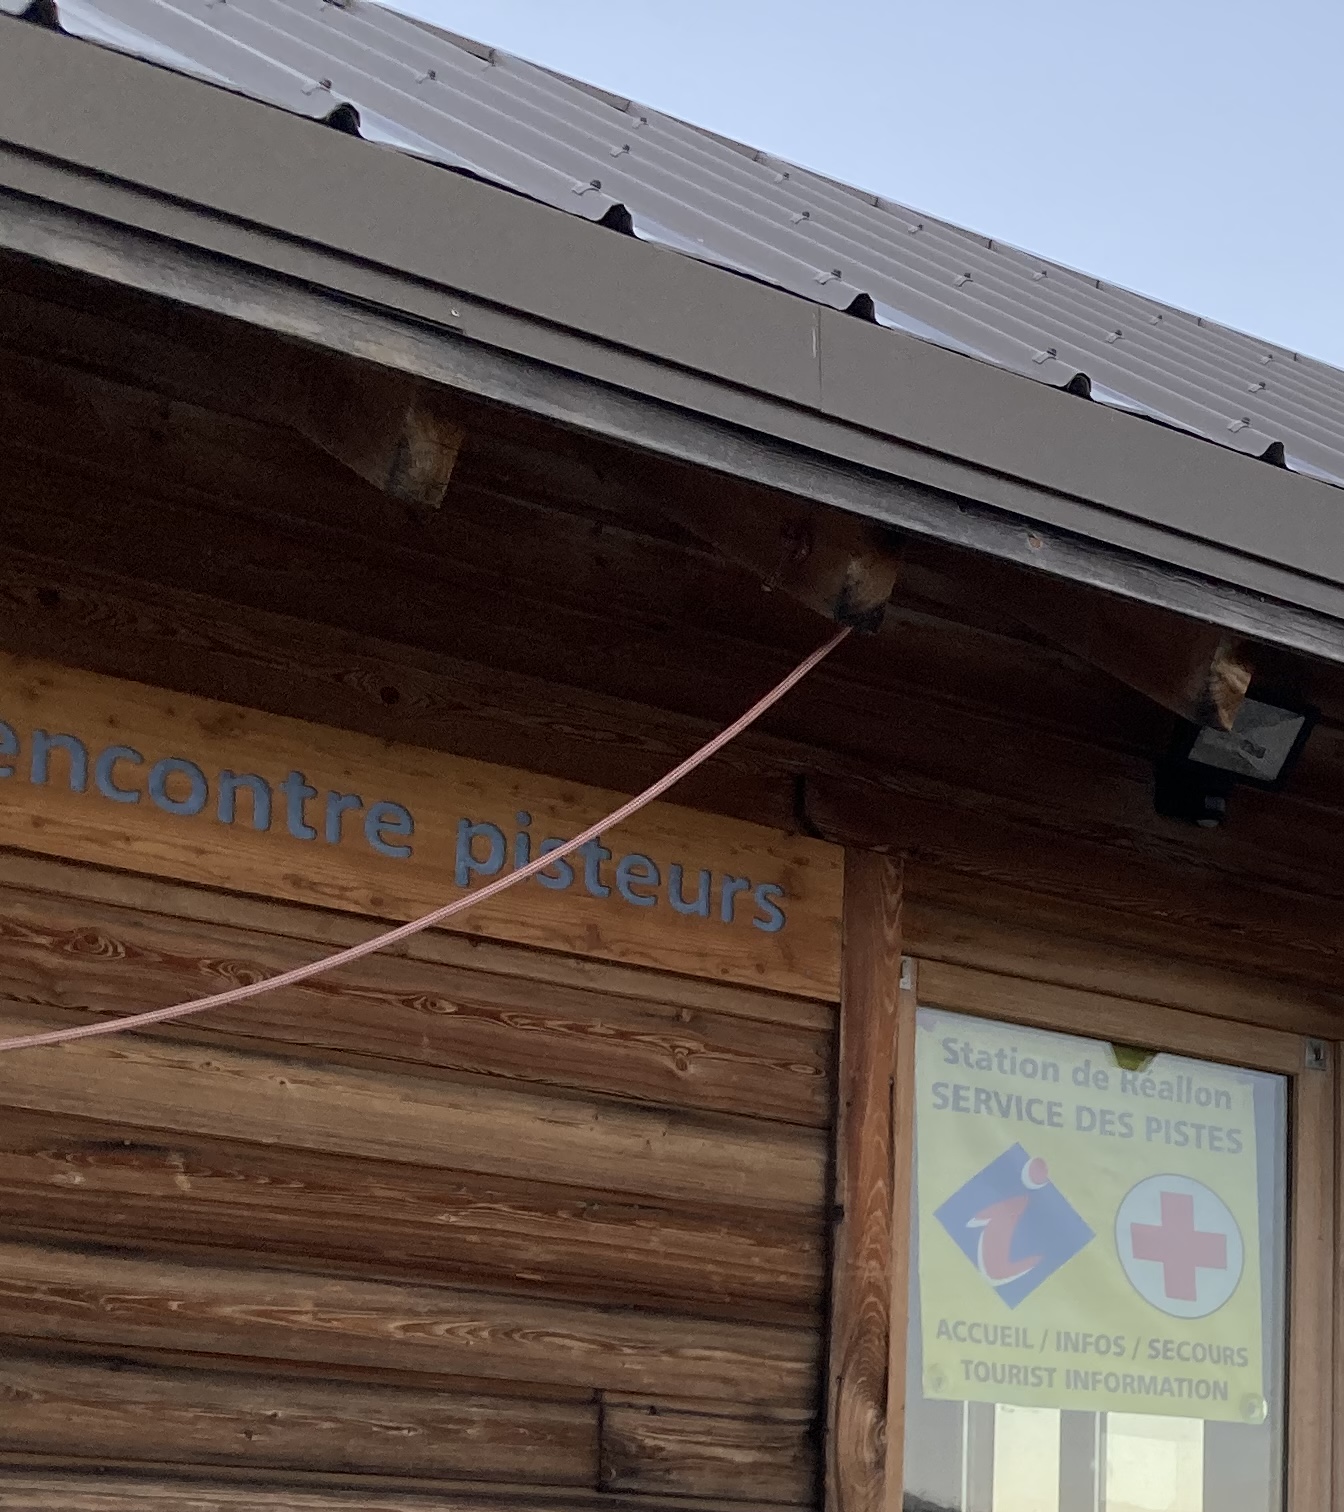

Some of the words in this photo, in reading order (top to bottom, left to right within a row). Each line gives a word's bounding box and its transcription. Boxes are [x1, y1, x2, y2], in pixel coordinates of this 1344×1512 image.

[455, 811, 787, 934] pisteurs
[942, 1037, 1060, 1083] Station
[1071, 1060, 1110, 1091] de
[1120, 1069, 1233, 1110] Réallon
[931, 1081, 1064, 1128] SERVICE
[1075, 1105, 1134, 1139] DES
[1145, 1115, 1243, 1155] PISTES
[935, 1318, 1034, 1350] ACCUEIL
[1056, 1330, 1126, 1358] INFOS
[1148, 1338, 1249, 1368] SECOURS
[961, 1359, 1057, 1390] TOURIST
[1065, 1367, 1229, 1401] INFORMATION
